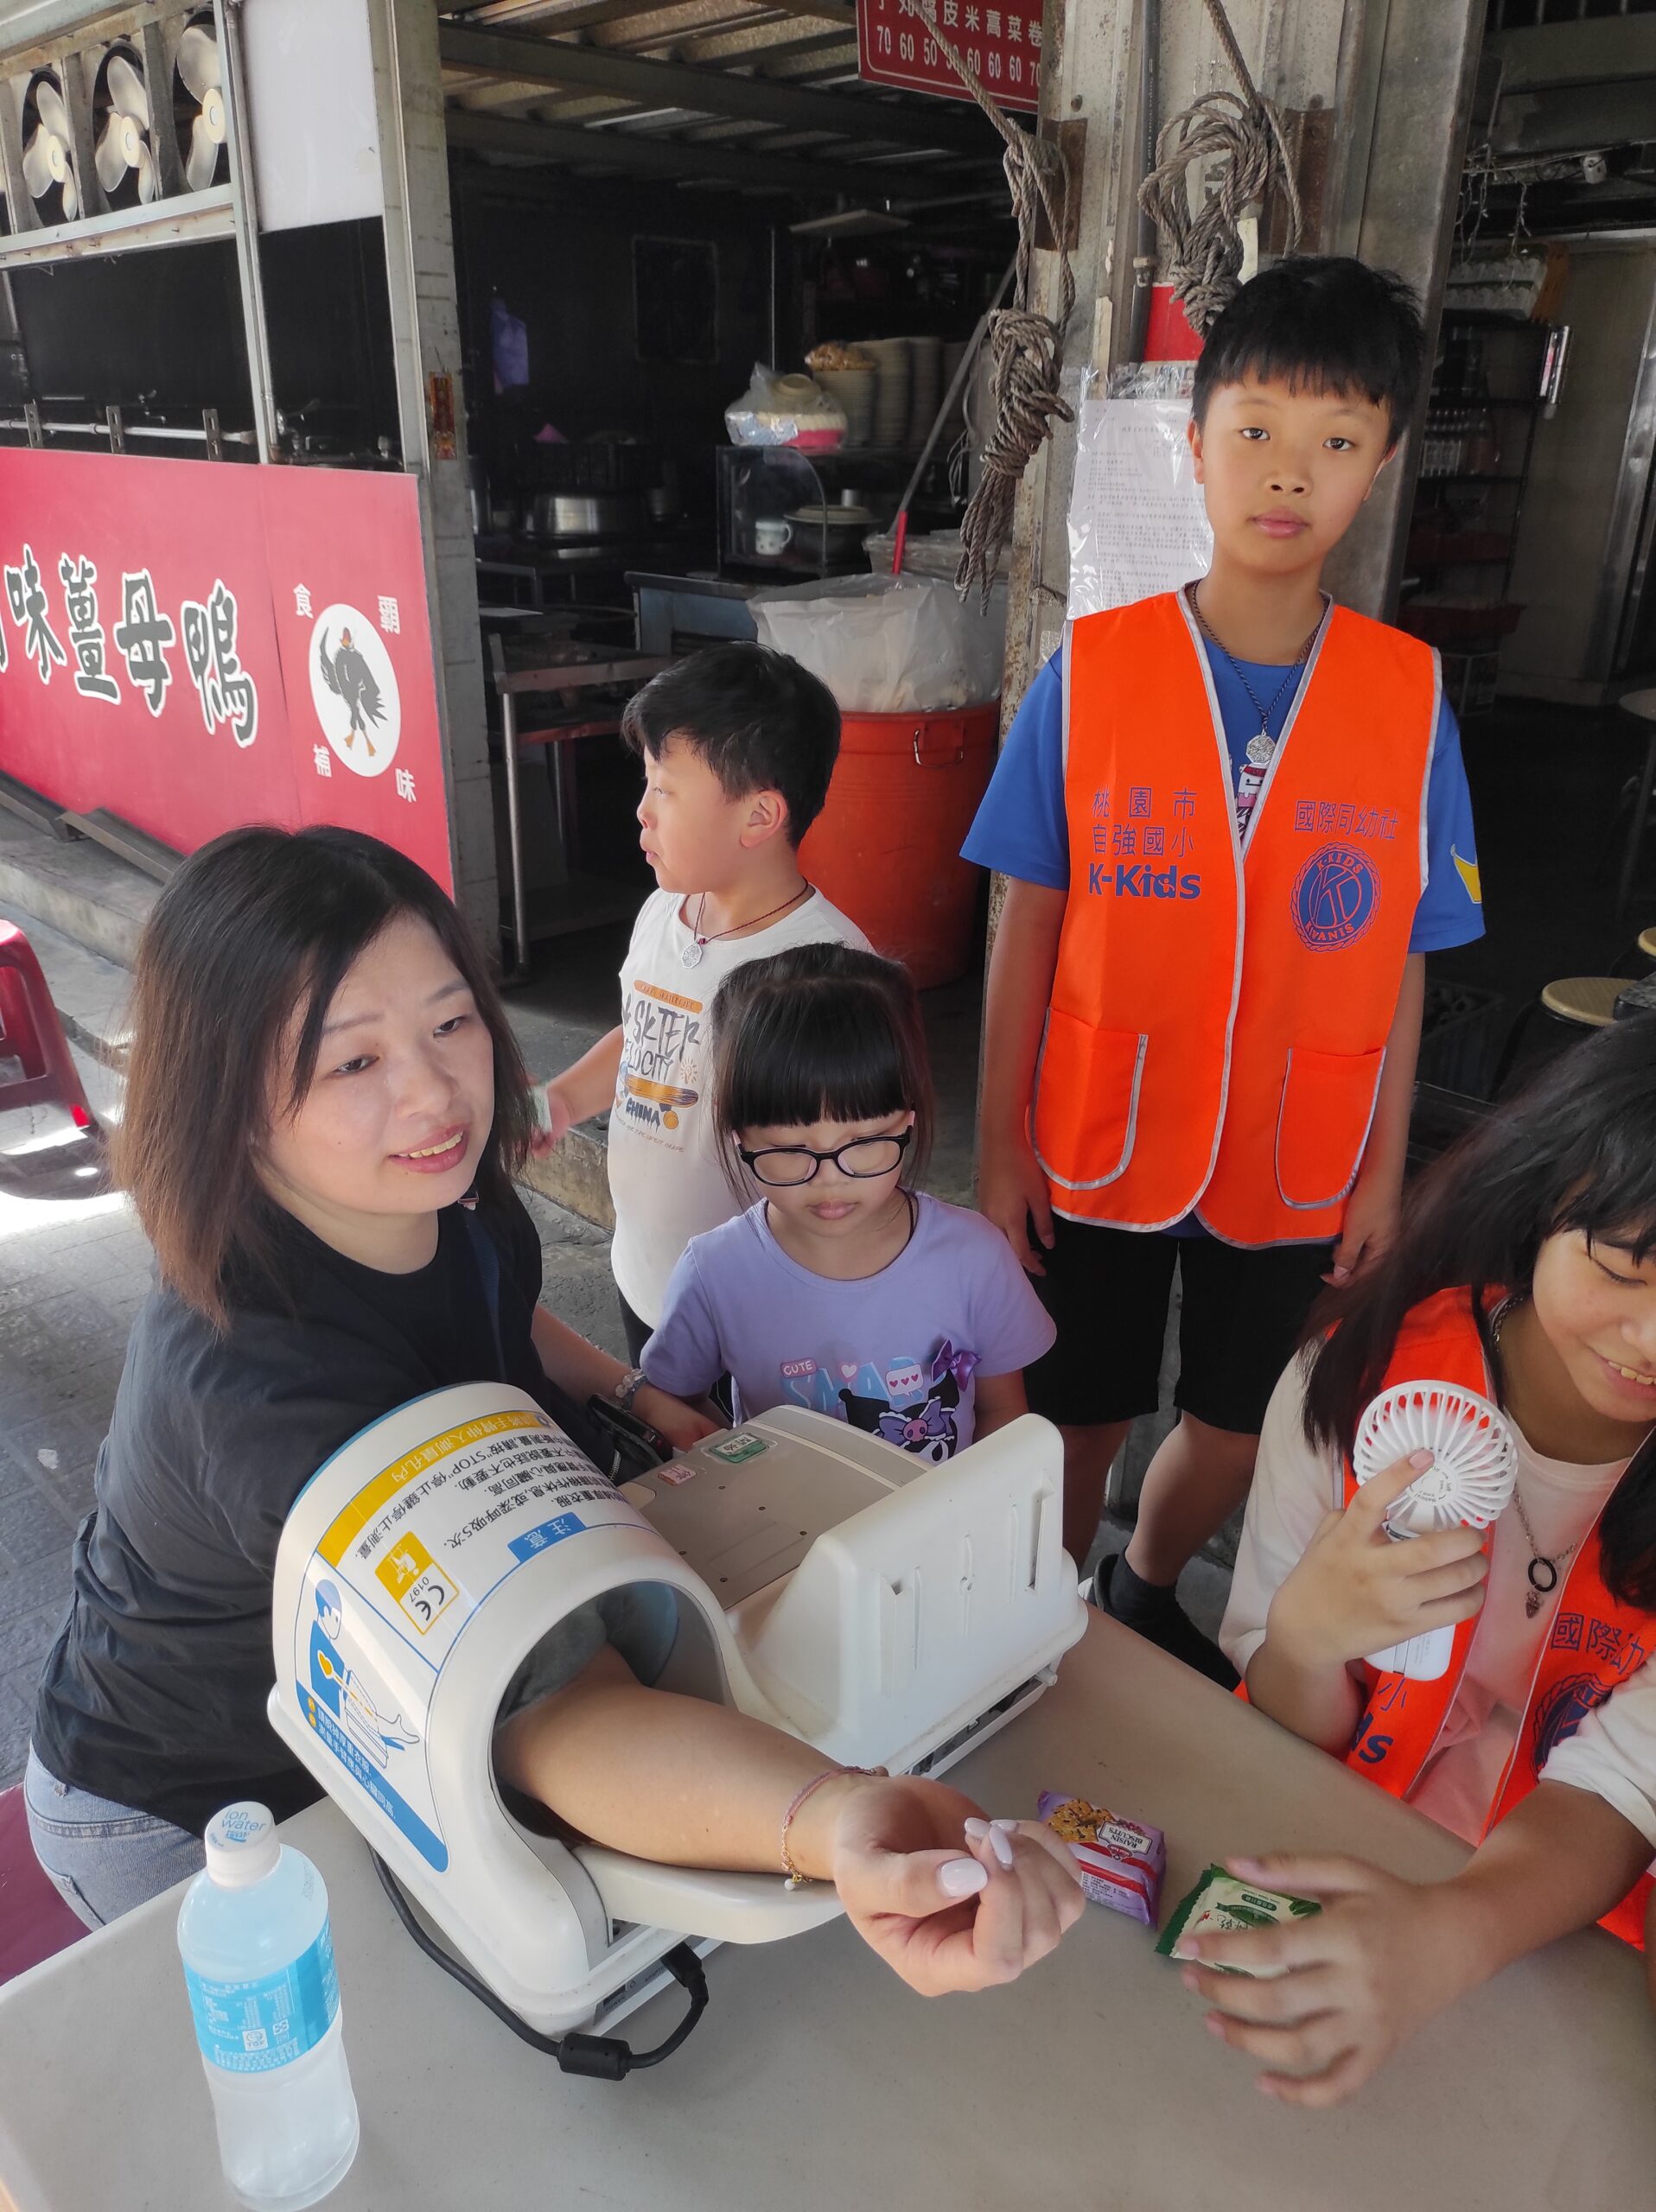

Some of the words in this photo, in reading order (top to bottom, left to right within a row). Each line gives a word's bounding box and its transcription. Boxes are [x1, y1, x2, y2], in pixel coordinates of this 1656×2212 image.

[876, 25, 891, 54] 70
[900, 33, 914, 62] 60
[988, 51, 1001, 79] 60
[1009, 55, 1022, 82] 60
[0, 543, 258, 748] 味薑母鴨
[1092, 785, 1197, 819] 桃園市
[1092, 823, 1194, 857] 自強國小
[1089, 862, 1201, 899] K-Kids
[783, 1361, 813, 1375] CUTE
[524, 1518, 571, 1548] 注意
[410, 1576, 430, 1603] 0197
[221, 1818, 266, 1831] water
[225, 1808, 249, 1821] ion
[1109, 1827, 1143, 1844] BISCUITS
[1111, 1834, 1137, 1848] RAISIN
